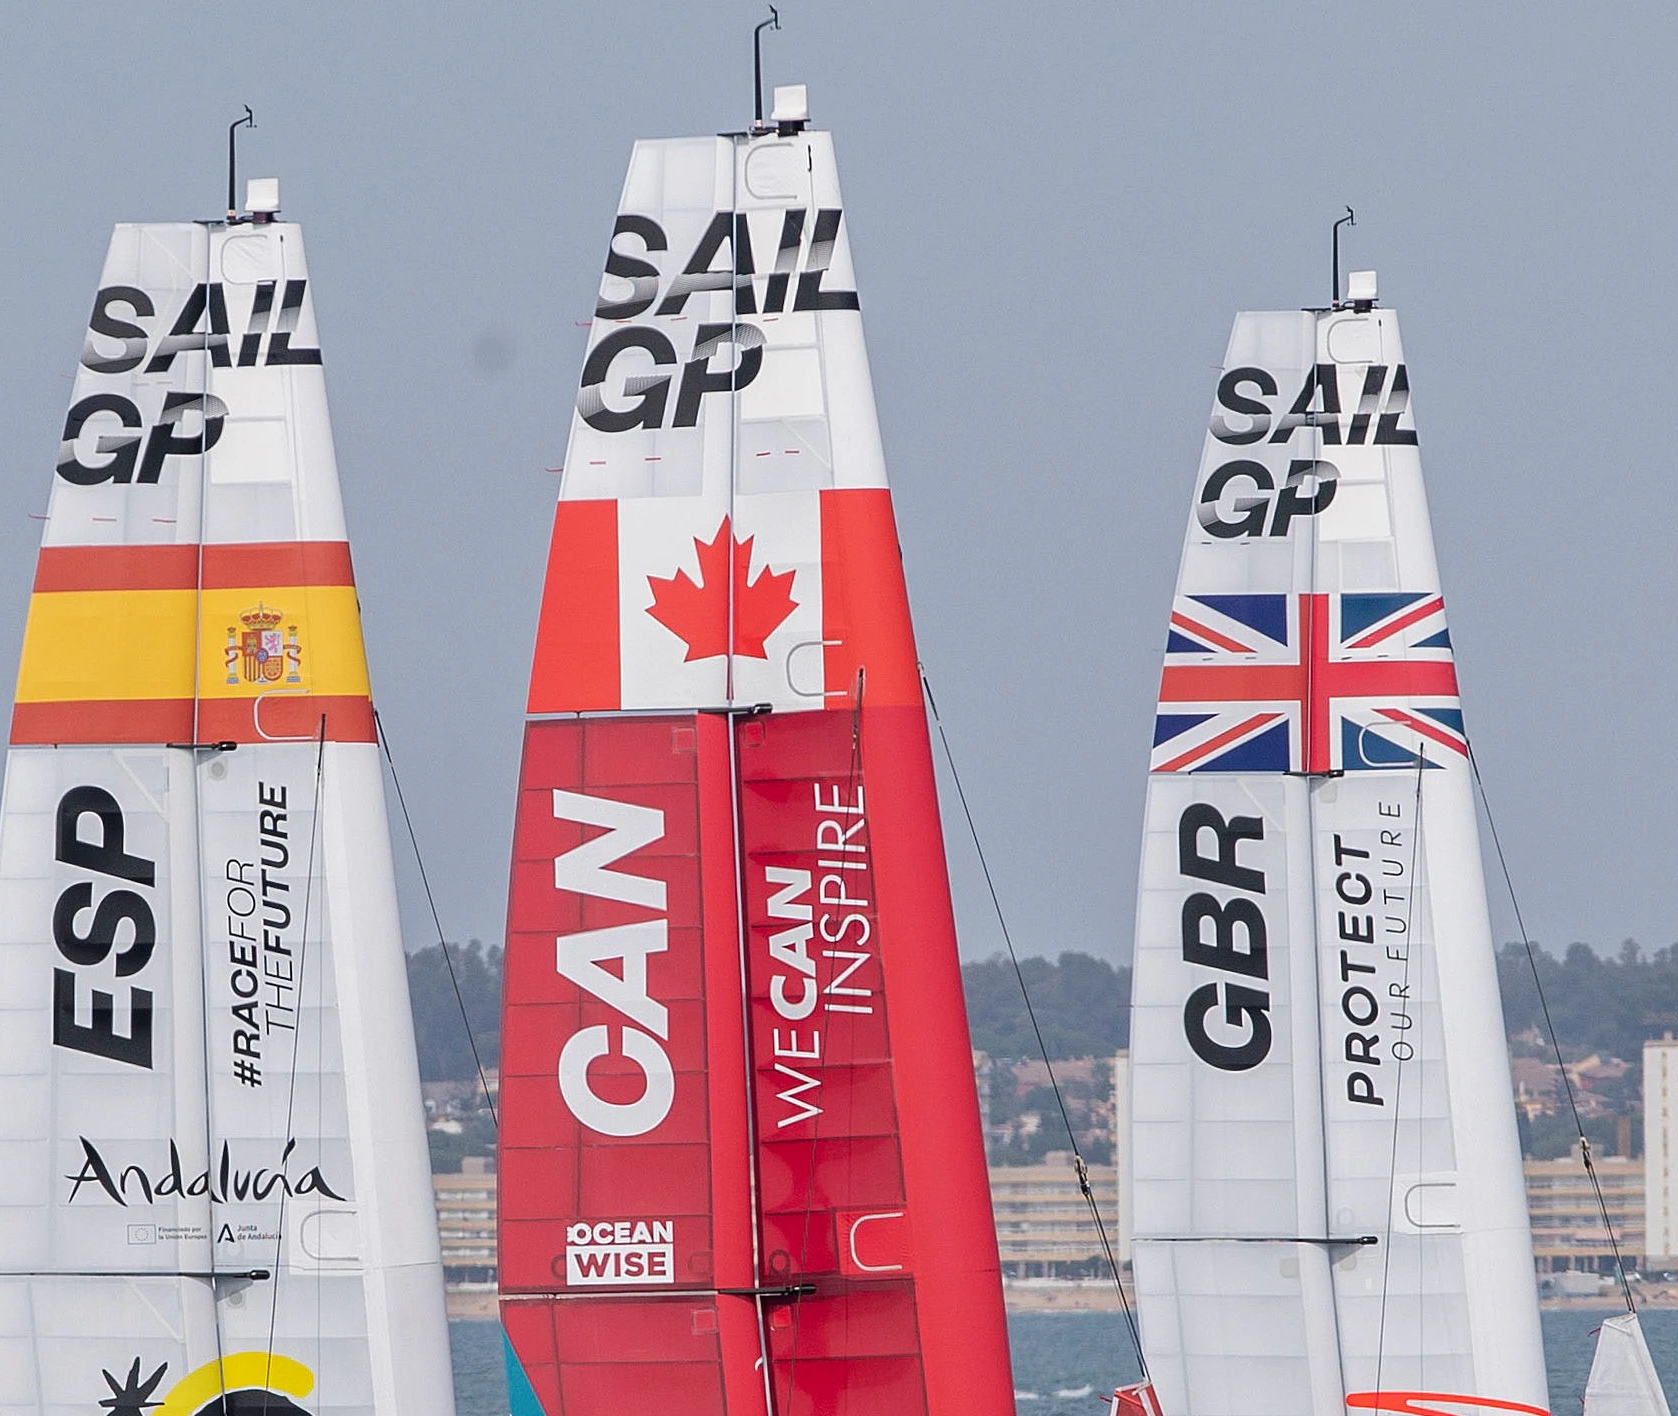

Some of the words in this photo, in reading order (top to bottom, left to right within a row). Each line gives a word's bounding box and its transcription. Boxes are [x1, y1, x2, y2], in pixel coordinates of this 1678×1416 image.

[594, 208, 860, 320] SAIL
[79, 279, 322, 374] SAIL
[576, 322, 767, 432] GP
[55, 391, 229, 485] GP
[1210, 363, 1419, 445] SAIL
[1197, 459, 1341, 538] GP
[52, 784, 156, 1070] ESP
[259, 781, 296, 1034] THEFUTURE
[814, 782, 874, 1014] INSPIRE
[1178, 802, 1272, 1072] GBR
[1379, 801, 1409, 963] FUTURE
[226, 857, 263, 1088] #RACEFOR
[552, 788, 675, 1136] CAN
[1333, 834, 1385, 1107] PROTECT
[1389, 983, 1415, 1062] OUR
[64, 1135, 348, 1207] Andalucía
[566, 1220, 674, 1245] OCEAN
[573, 1250, 667, 1278] WISE
